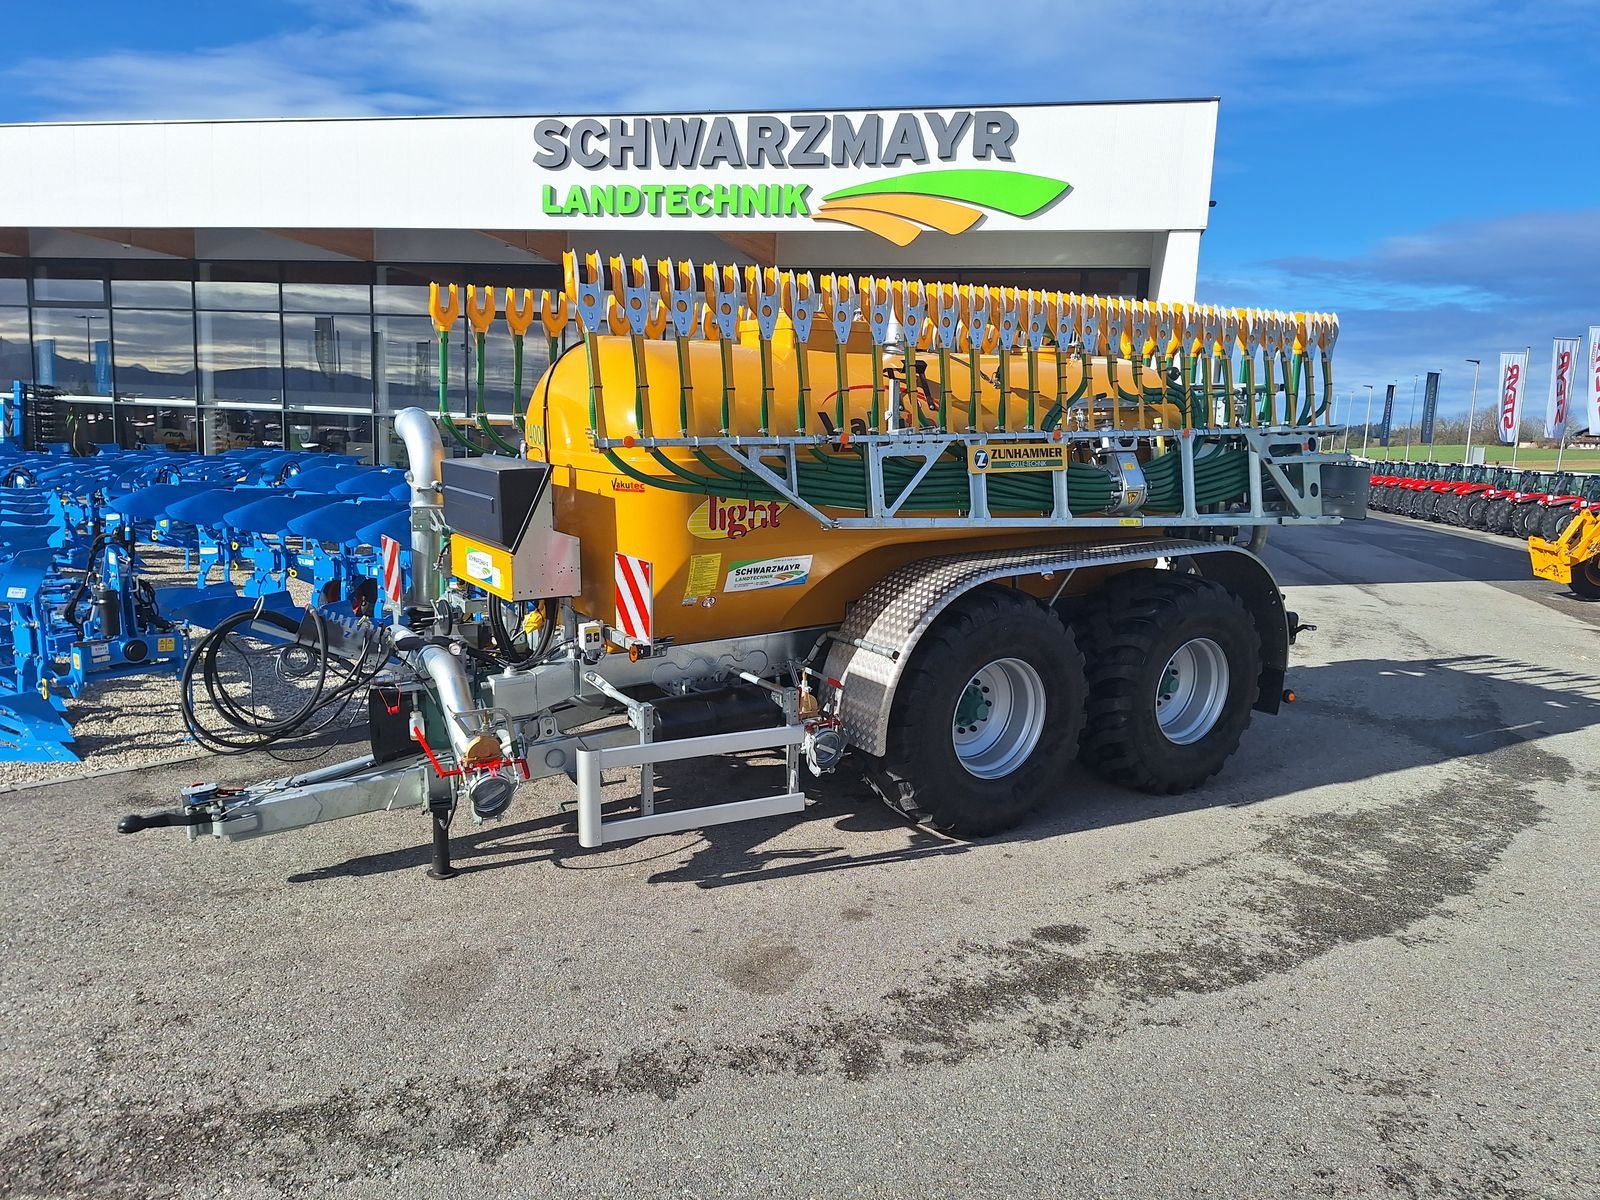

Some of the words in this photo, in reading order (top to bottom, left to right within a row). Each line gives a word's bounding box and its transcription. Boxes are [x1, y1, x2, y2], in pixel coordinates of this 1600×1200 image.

[533, 112, 1017, 170] SCHWARZMAYR
[542, 184, 813, 217] LANDTECHNIK
[991, 447, 1062, 459] ZUNHAMMER
[611, 478, 645, 490] Vakutec
[708, 495, 780, 539] light
[735, 564, 801, 576] SCHWARZMAYR
[735, 574, 773, 582] LANDTECHNIK
